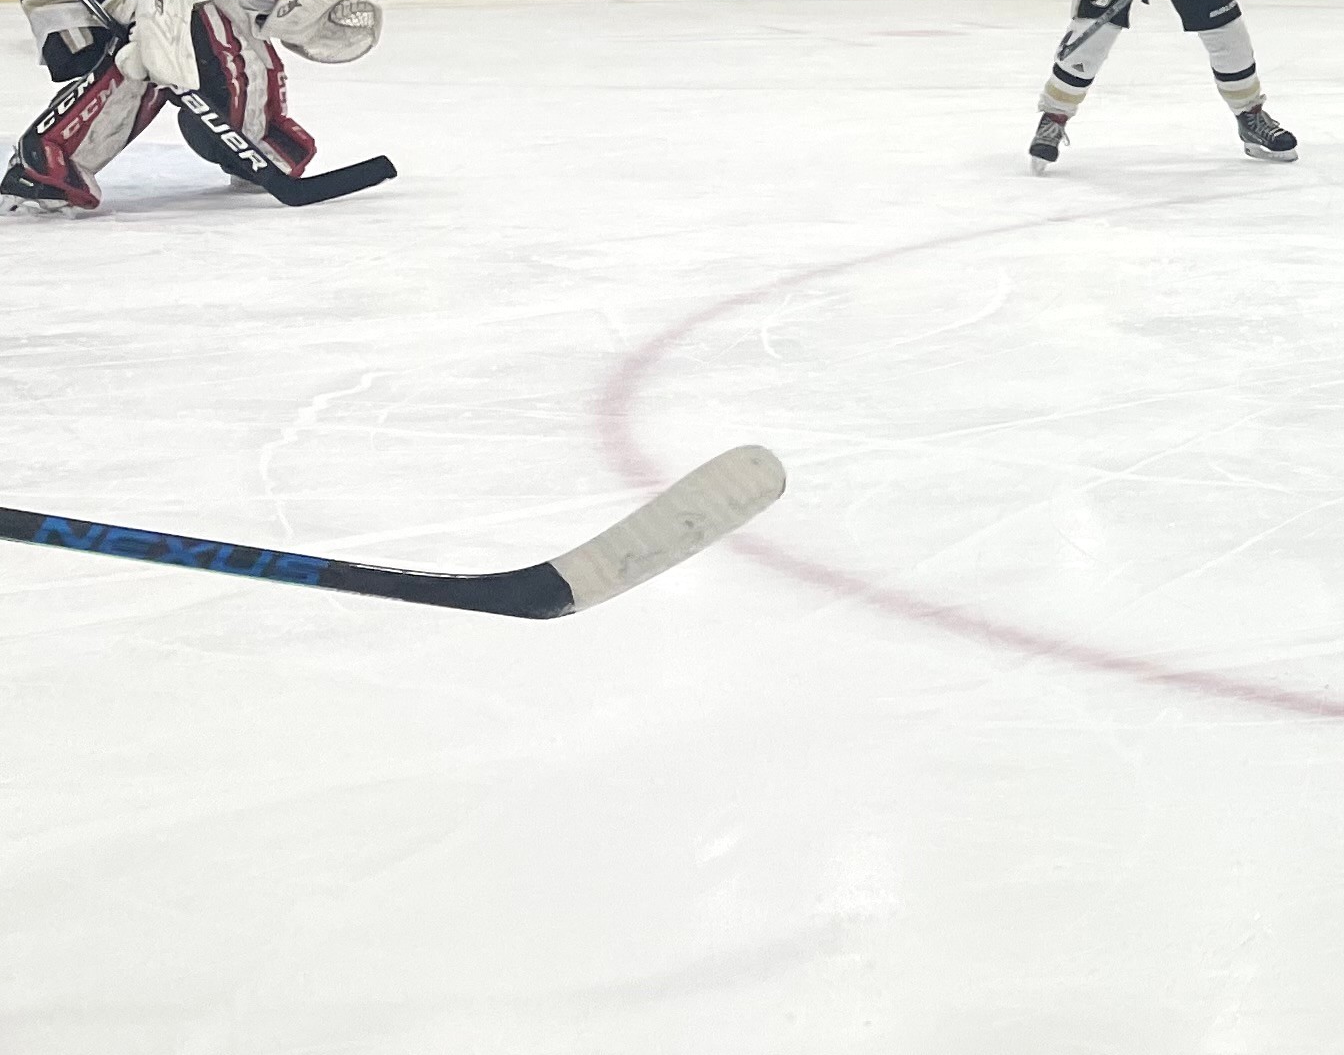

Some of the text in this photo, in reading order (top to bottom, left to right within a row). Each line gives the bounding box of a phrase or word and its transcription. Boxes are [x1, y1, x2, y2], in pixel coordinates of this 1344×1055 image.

[36, 72, 95, 135] CCM
[61, 78, 118, 141] CCM
[181, 92, 268, 173] AUER
[34, 517, 331, 586] NEXUS
